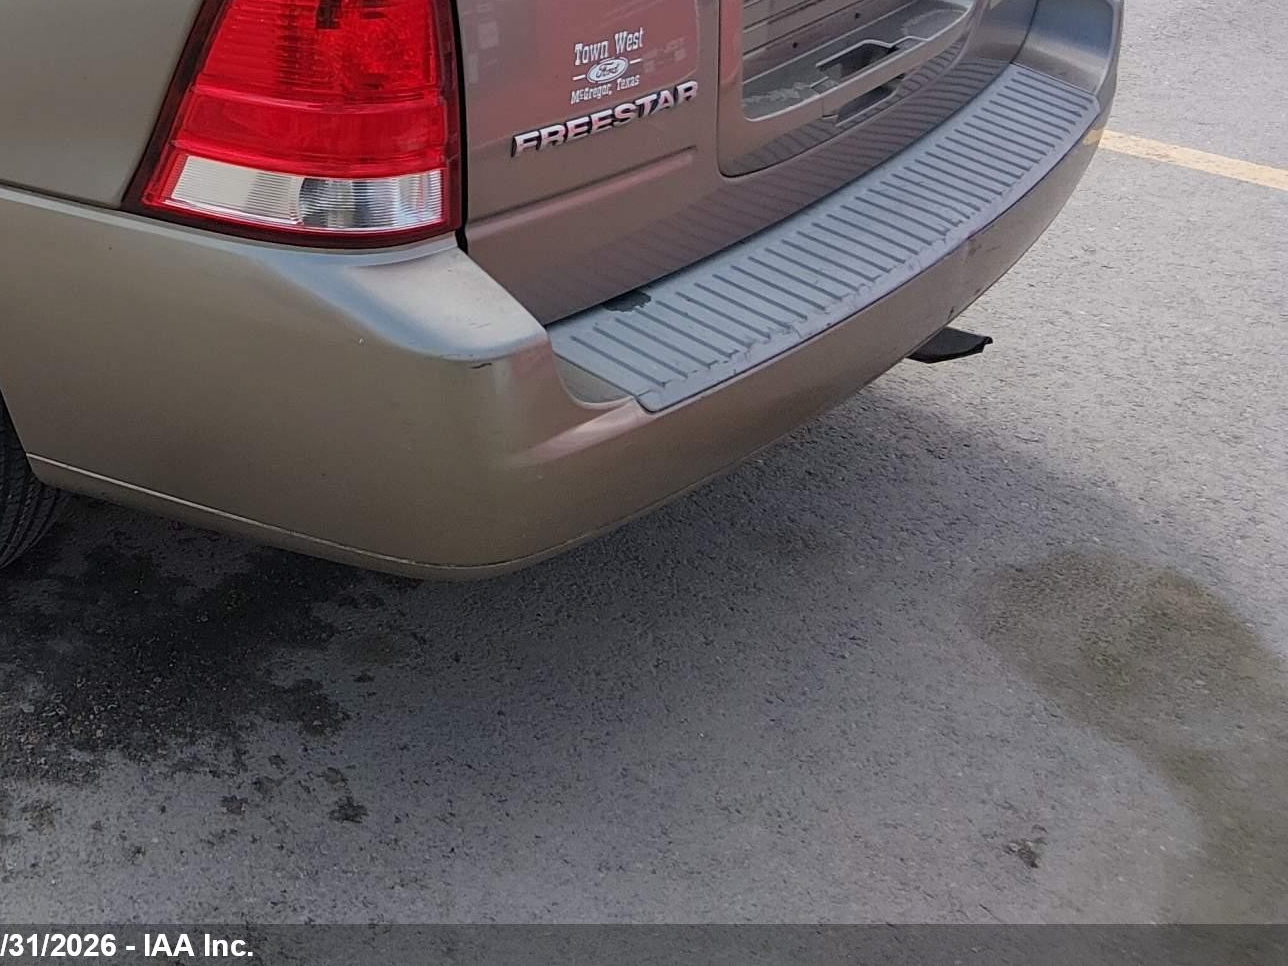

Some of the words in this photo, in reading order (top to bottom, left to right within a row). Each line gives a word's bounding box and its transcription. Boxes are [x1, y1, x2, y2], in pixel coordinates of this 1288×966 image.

[574, 39, 609, 66] Town
[614, 26, 645, 56] West
[616, 74, 641, 92] Texas
[510, 80, 699, 158] FREESTAR
